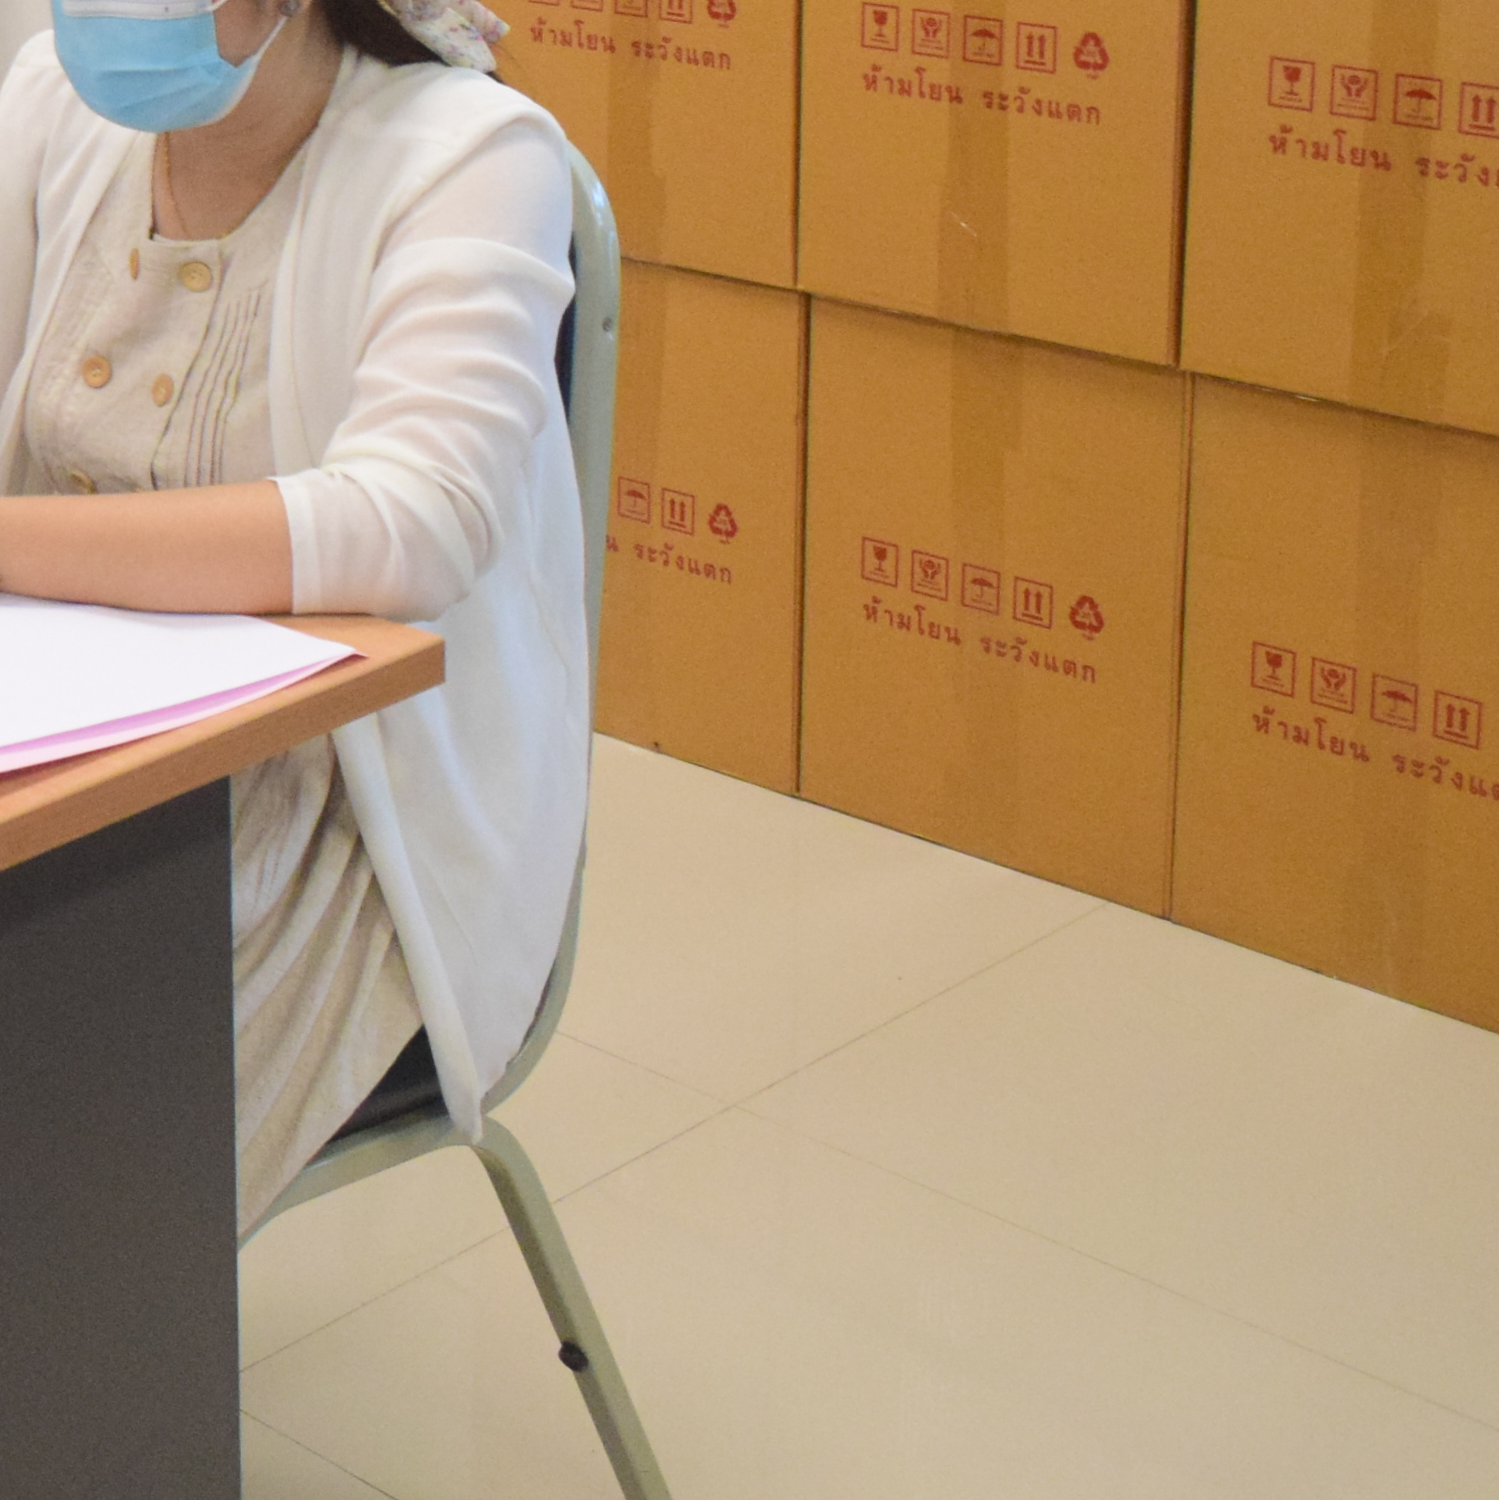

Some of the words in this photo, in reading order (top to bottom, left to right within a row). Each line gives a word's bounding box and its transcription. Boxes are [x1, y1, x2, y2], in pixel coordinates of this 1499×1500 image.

[530, 16, 616, 54] ห้ามโยน
[631, 36, 731, 70] ระวังแตก
[862, 64, 963, 105] ห้ามโยน
[981, 87, 1101, 125] ระวังแตก
[1269, 123, 1392, 172] ห้ามโยน
[1414, 153, 1499, 187] ระวัง
[634, 542, 732, 584] ระวังแตก
[863, 596, 962, 645] ห้ามโยน
[980, 637, 1098, 684] ระวังแตก
[1253, 705, 1370, 762] ห้ามโยน
